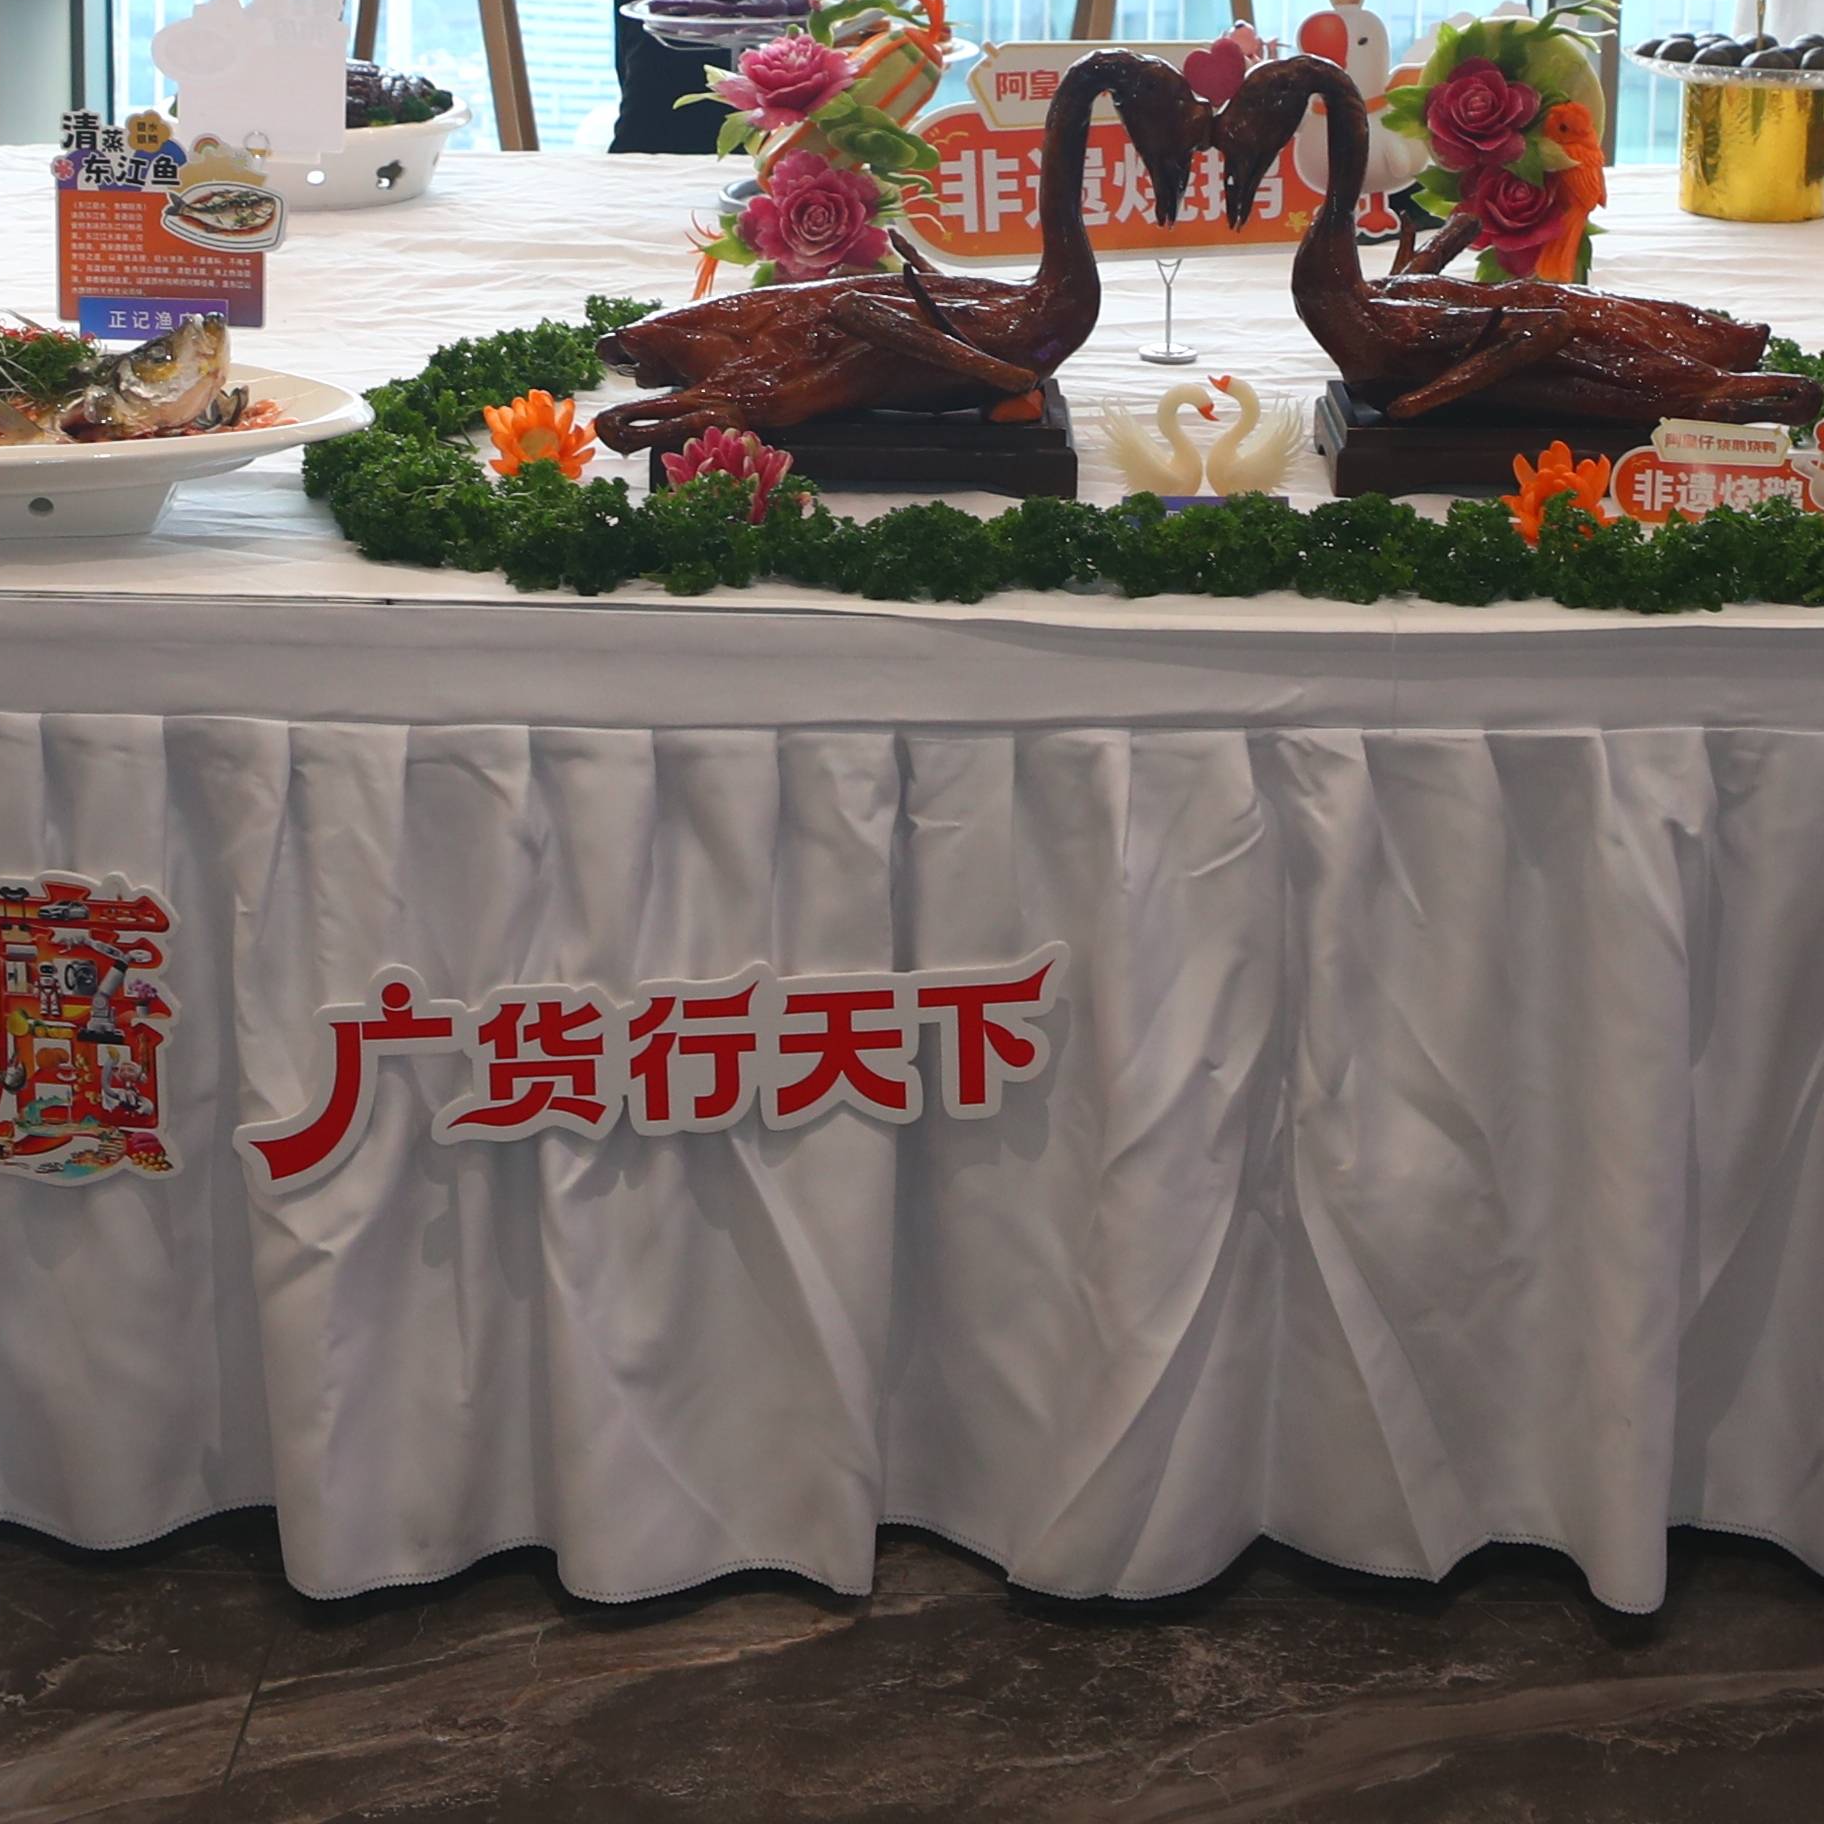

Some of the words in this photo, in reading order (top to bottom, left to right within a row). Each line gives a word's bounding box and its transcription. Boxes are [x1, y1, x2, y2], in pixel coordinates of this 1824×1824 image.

[63, 113, 125, 152] 清蒸
[84, 155, 181, 186] 东江鱼
[248, 958, 1056, 1182] 广货行天下
